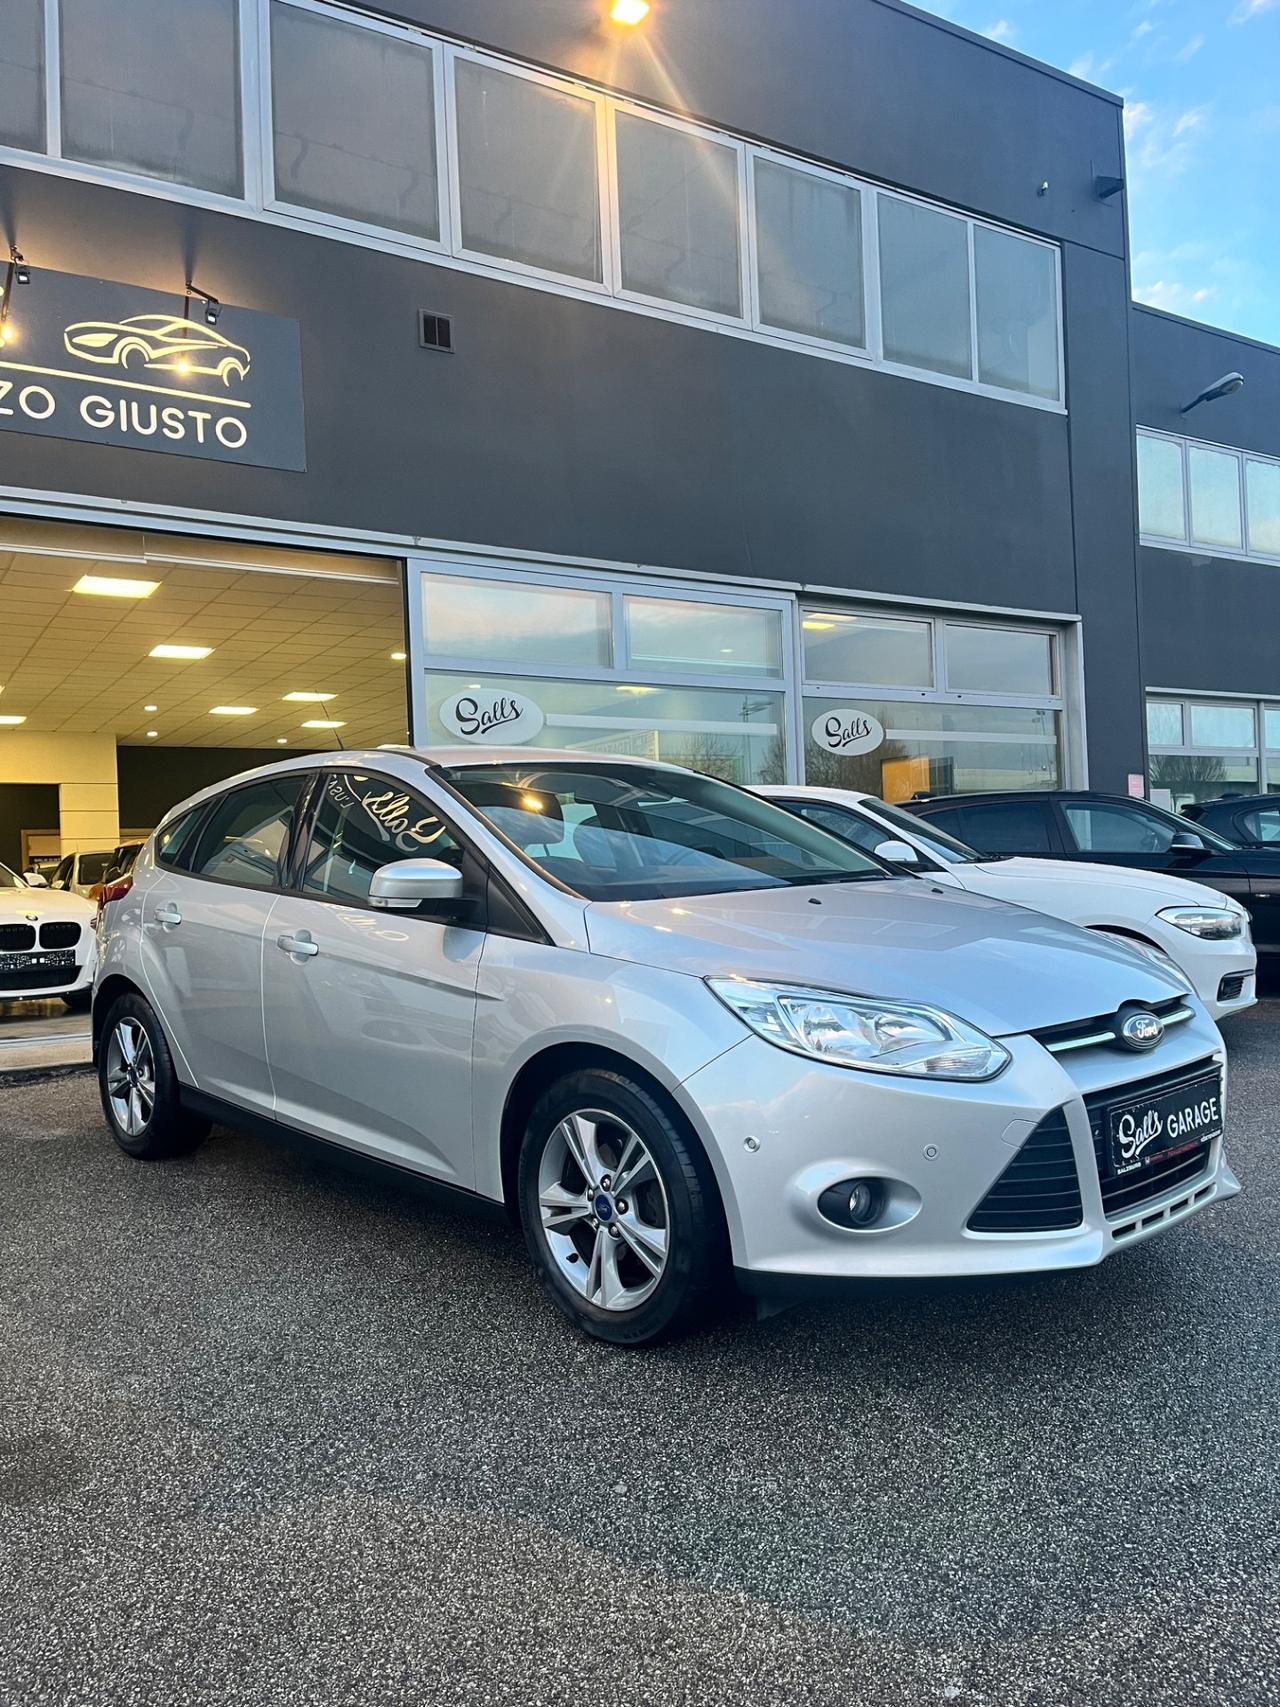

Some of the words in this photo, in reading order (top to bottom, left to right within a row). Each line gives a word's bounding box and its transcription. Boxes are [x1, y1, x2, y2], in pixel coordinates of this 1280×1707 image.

[80, 395, 248, 449] GIUSTO
[1136, 1019, 1159, 1039] Ford
[1167, 1097, 1219, 1138] GARAGE
